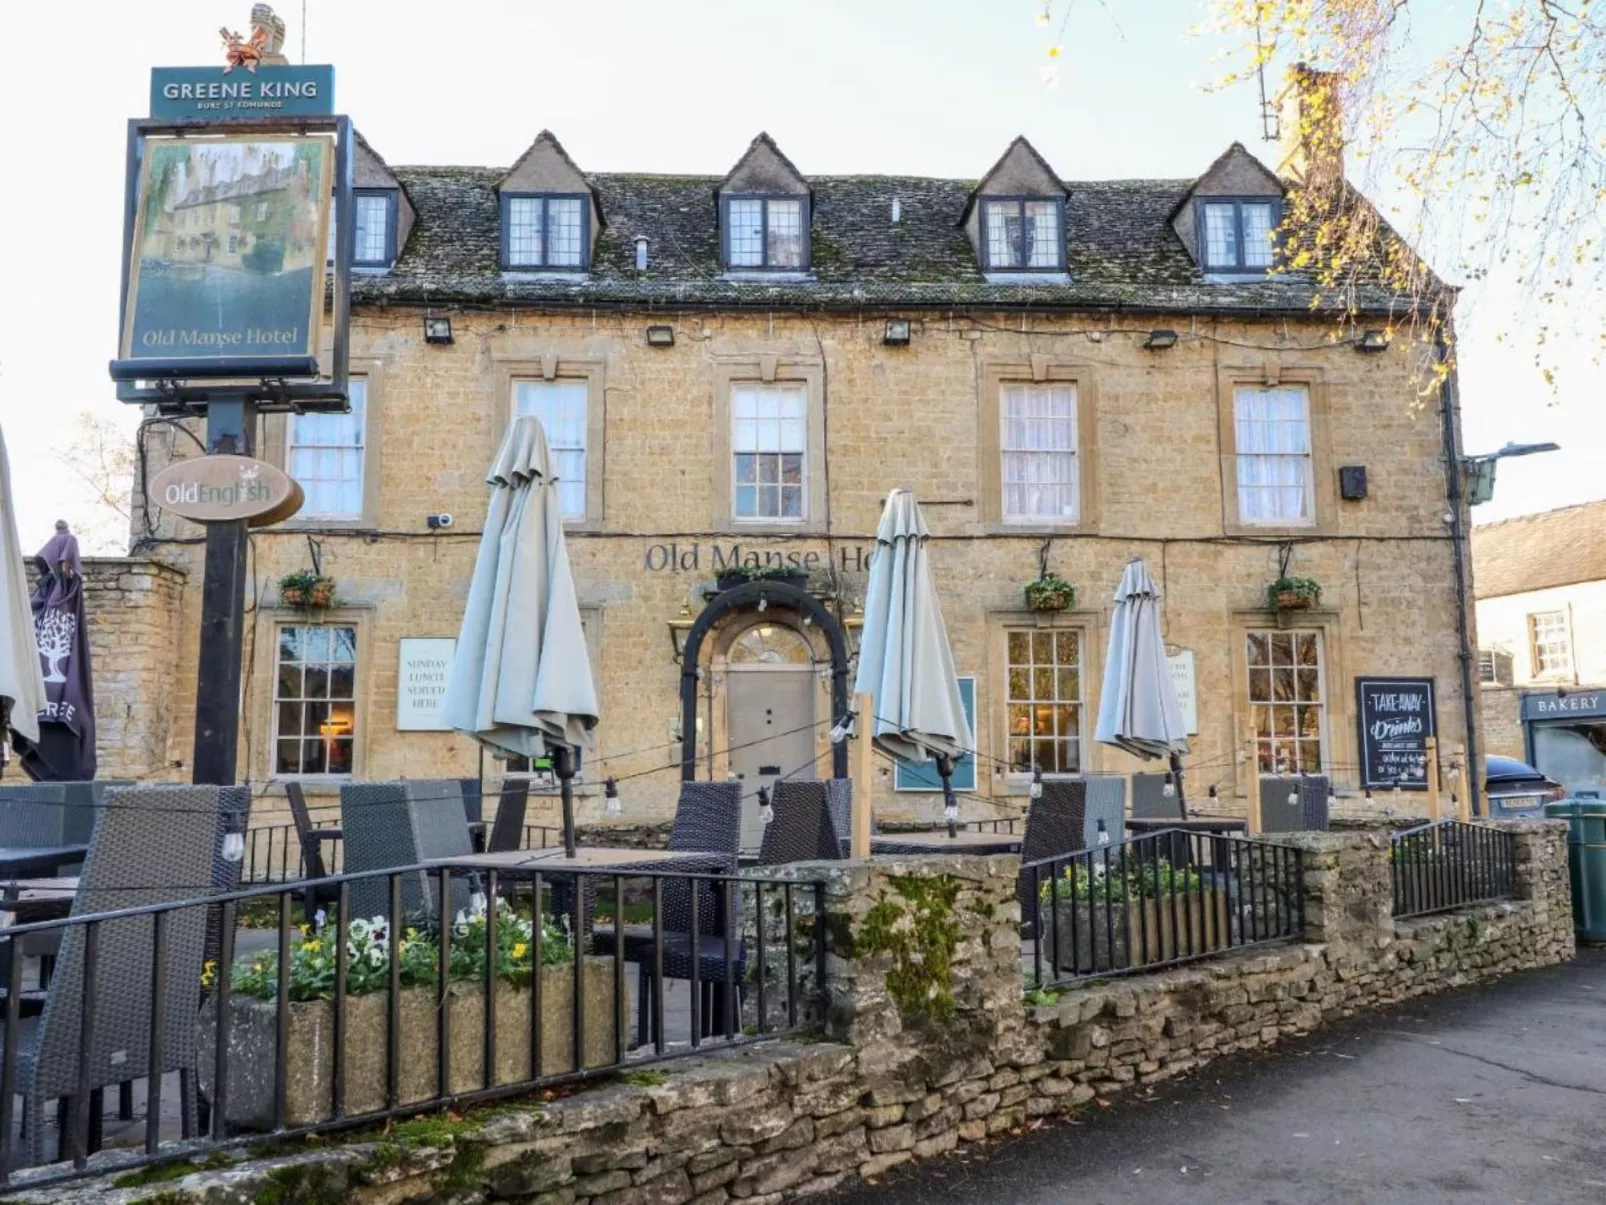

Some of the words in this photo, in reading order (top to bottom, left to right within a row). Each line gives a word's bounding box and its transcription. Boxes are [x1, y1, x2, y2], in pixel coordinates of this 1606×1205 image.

[163, 82, 252, 99] GREENE
[260, 81, 318, 98] KING
[237, 100, 283, 109] EDMUNDS
[142, 329, 175, 346] Old
[178, 329, 242, 346] Manse
[246, 327, 298, 344] Hotel
[643, 542, 699, 572] Old
[711, 544, 820, 572] Manse
[1537, 696, 1599, 712] BAKERY
[1370, 716, 1422, 740] Drinks
